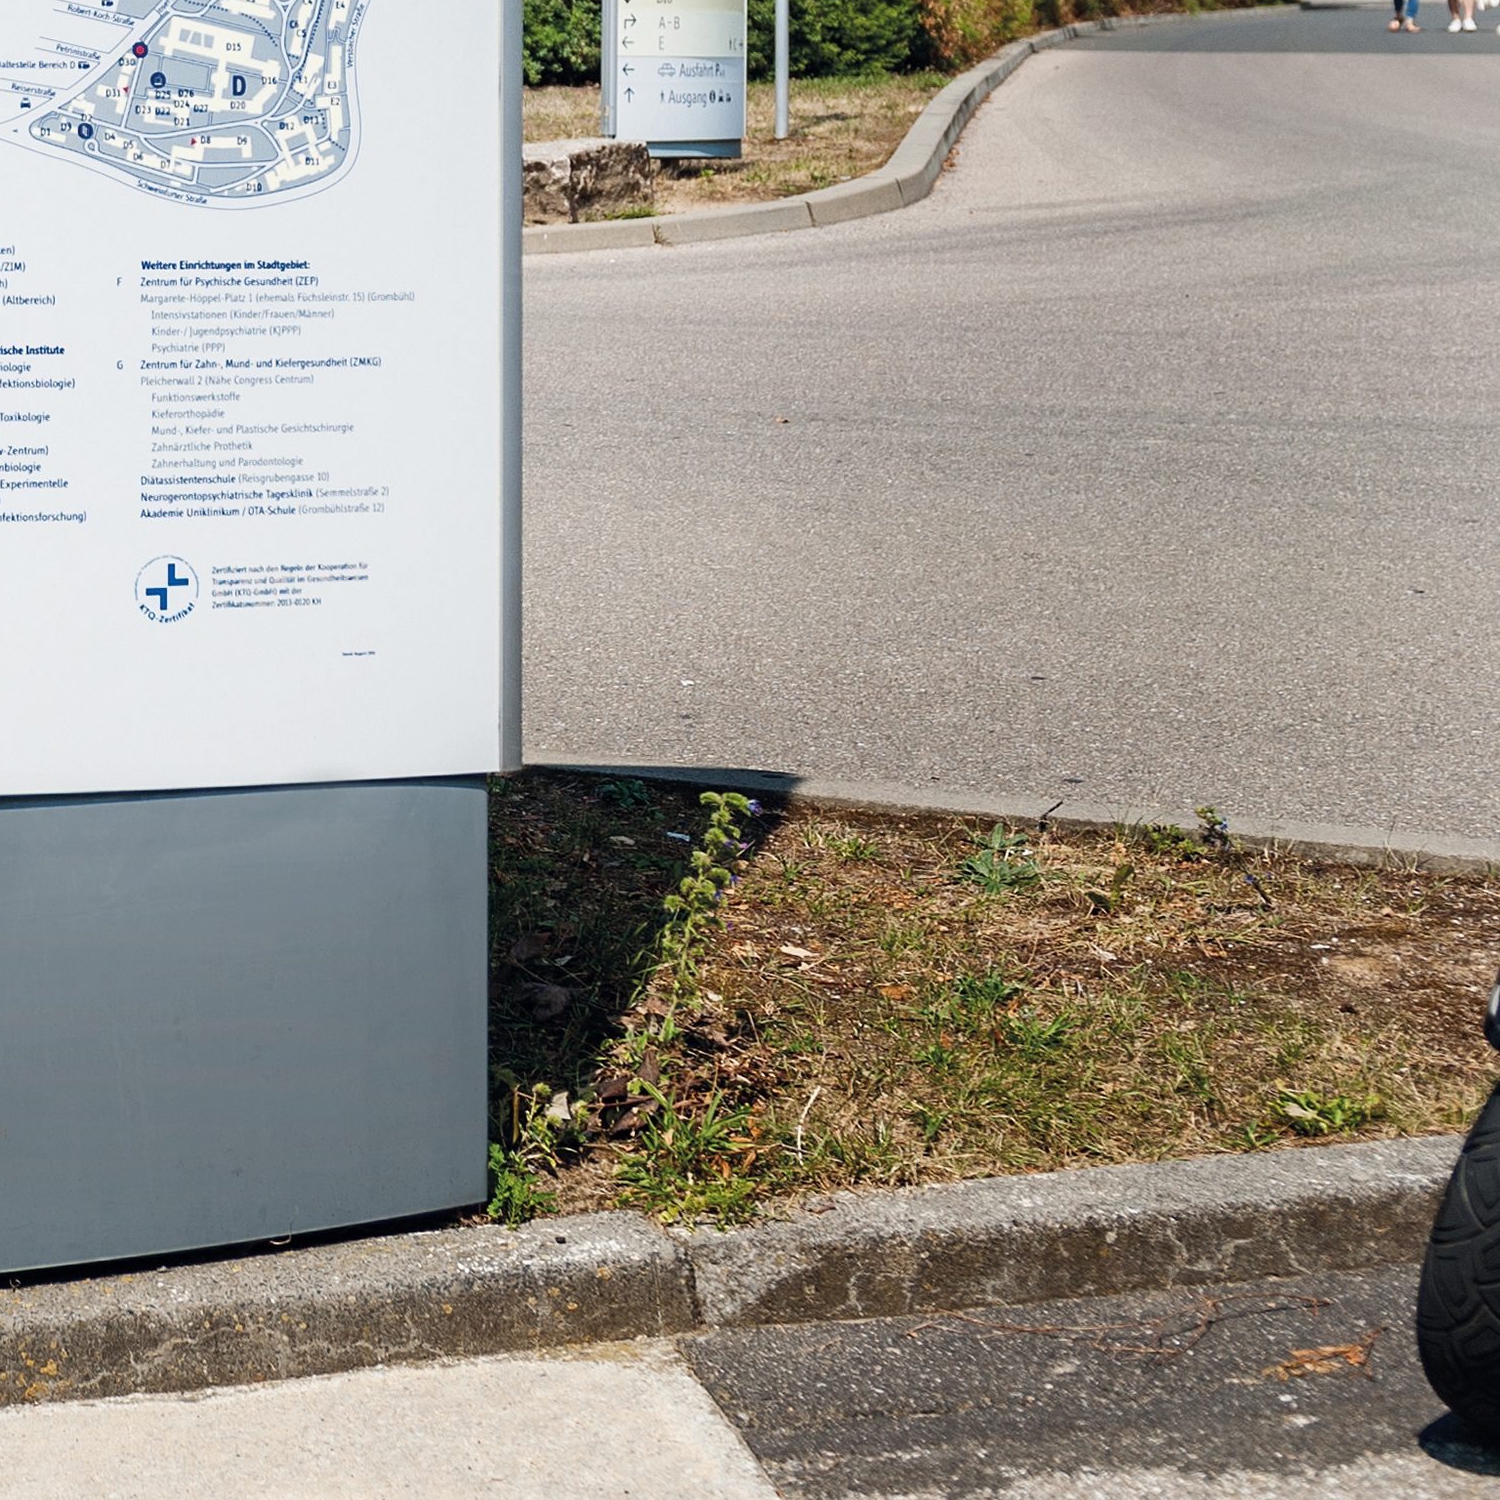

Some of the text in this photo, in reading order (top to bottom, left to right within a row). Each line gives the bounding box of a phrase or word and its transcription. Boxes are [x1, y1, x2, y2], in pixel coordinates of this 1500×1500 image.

[225, 42, 242, 52] D15
[659, 36, 665, 50] E
[679, 63, 714, 77] Ausfahrt
[232, 75, 246, 96] D
[668, 90, 707, 108] Ausgang
[140, 260, 310, 272] Weitere Einrichtungen im Stadtgebiet:
[116, 276, 318, 288] F Zentrum für Psychische Gesundheit (ZEP)
